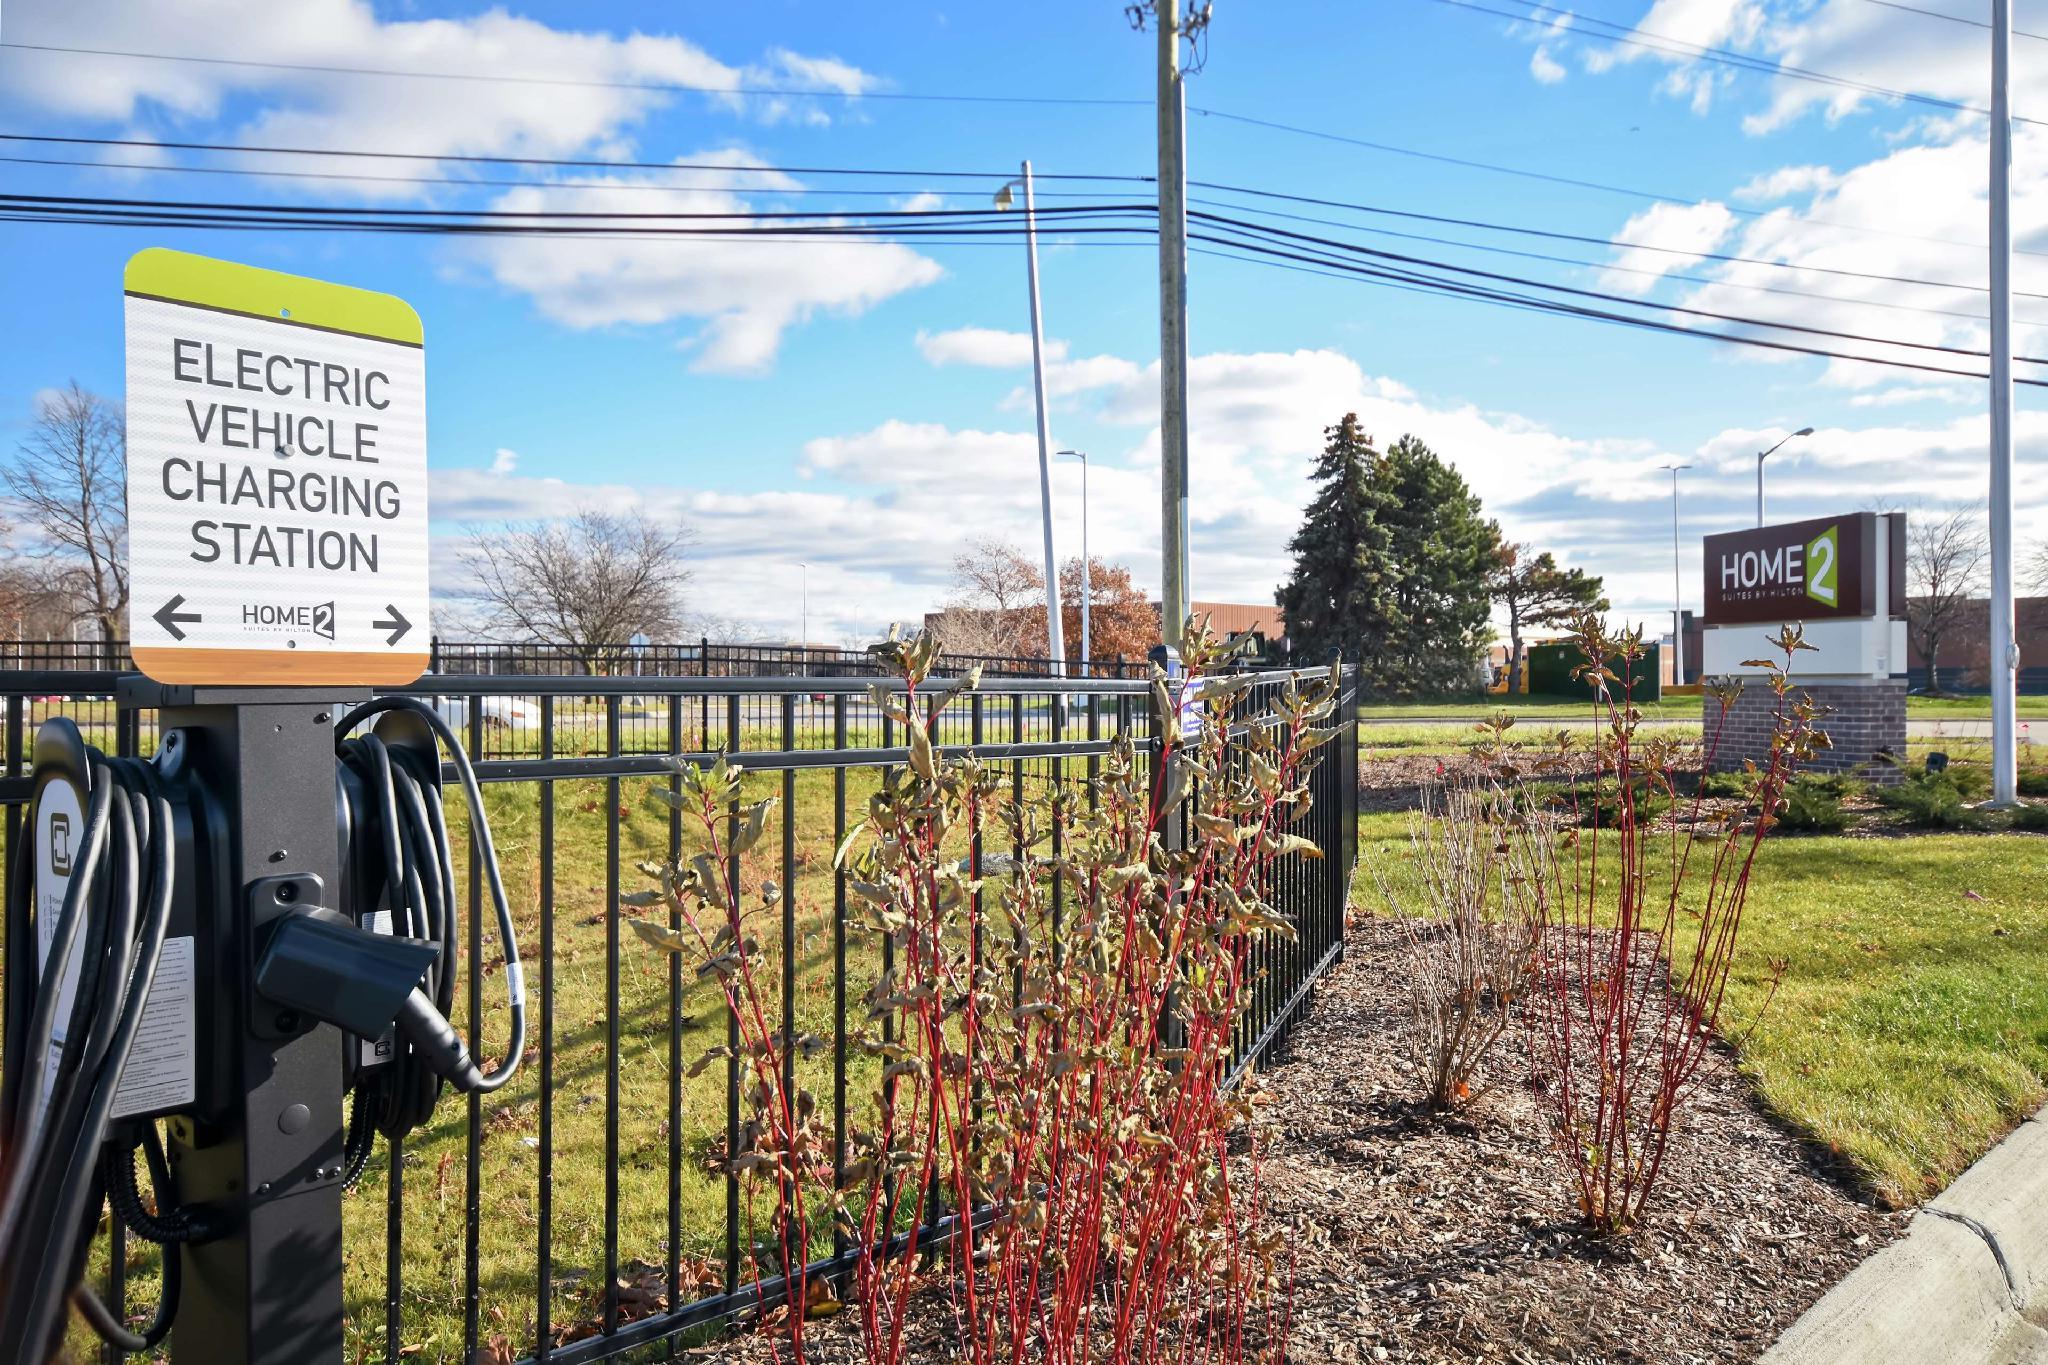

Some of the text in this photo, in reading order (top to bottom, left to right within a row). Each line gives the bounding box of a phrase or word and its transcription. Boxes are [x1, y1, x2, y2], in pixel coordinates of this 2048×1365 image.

[174, 338, 391, 410] ELECTRIC
[186, 399, 379, 464] VEHICLE
[162, 457, 401, 520] CHARGING
[190, 519, 379, 573] STATION
[1722, 591, 1752, 601] SUITES
[1770, 586, 1804, 598] HILTON
